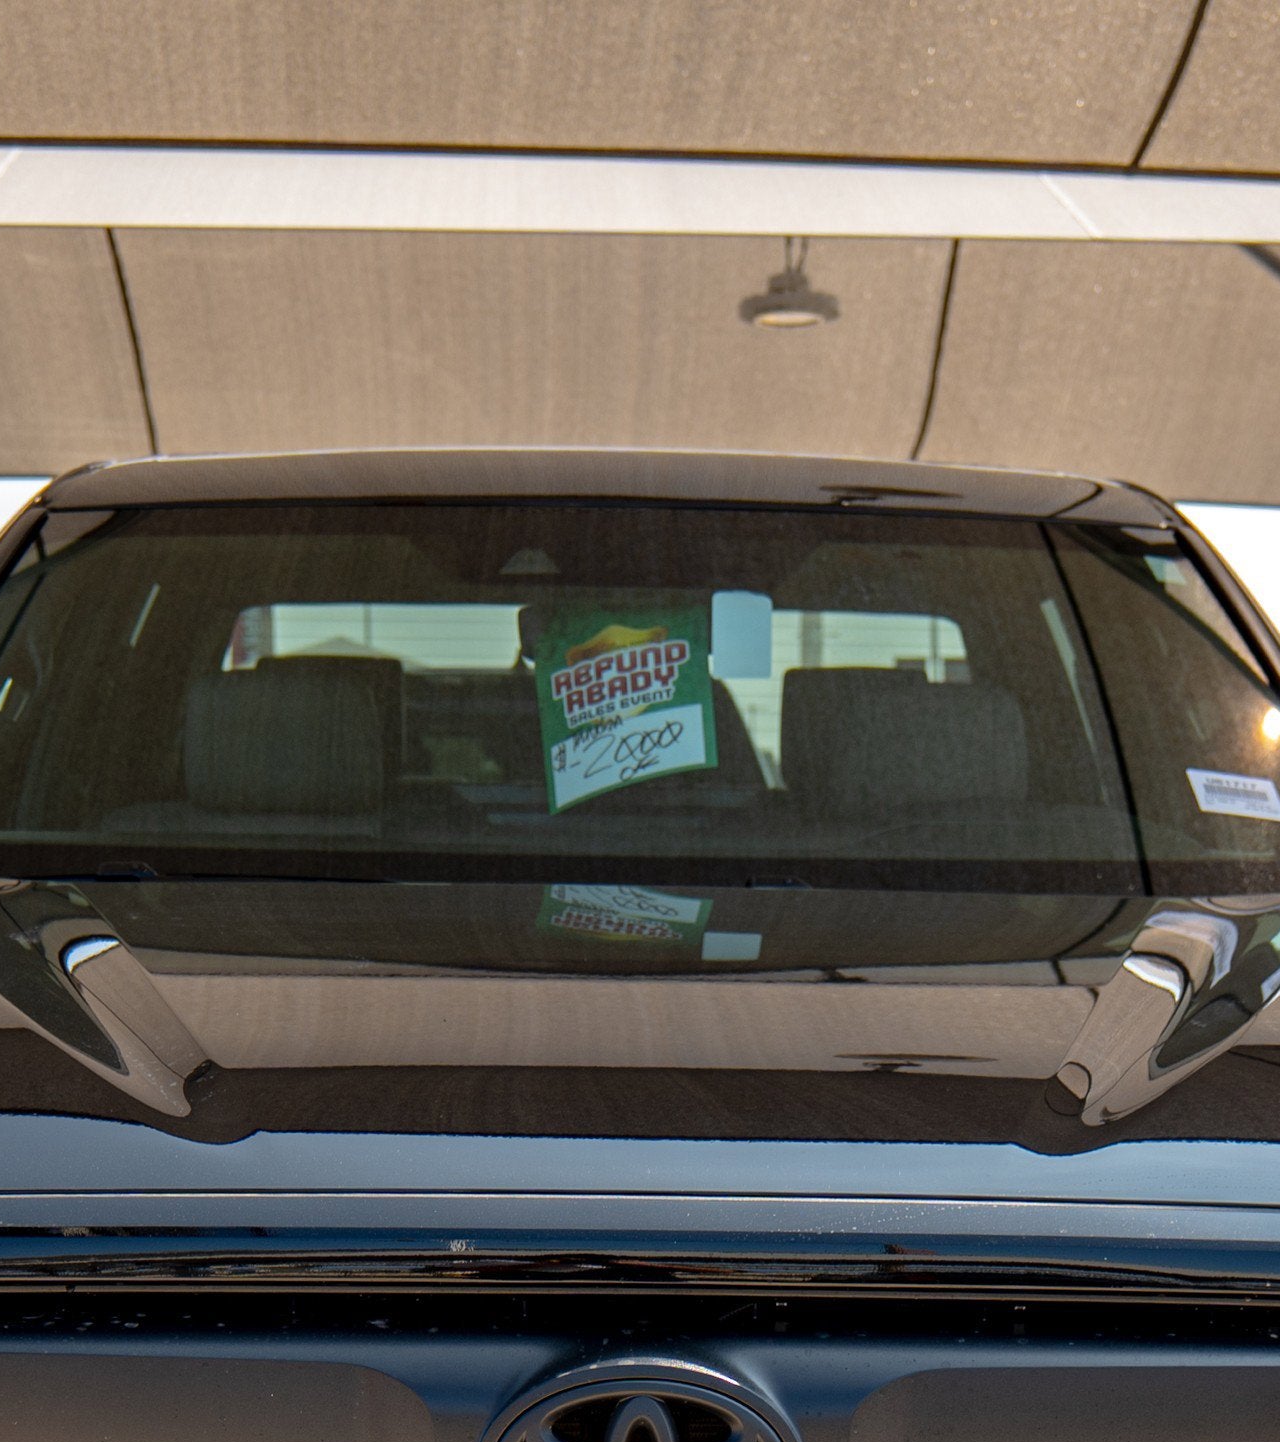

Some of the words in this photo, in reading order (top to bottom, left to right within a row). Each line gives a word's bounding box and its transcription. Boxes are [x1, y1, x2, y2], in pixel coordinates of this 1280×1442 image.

[553, 642, 687, 696] REFUND
[566, 666, 675, 714] READY
[570, 703, 616, 726] SALES
[621, 689, 674, 709] EVENT
